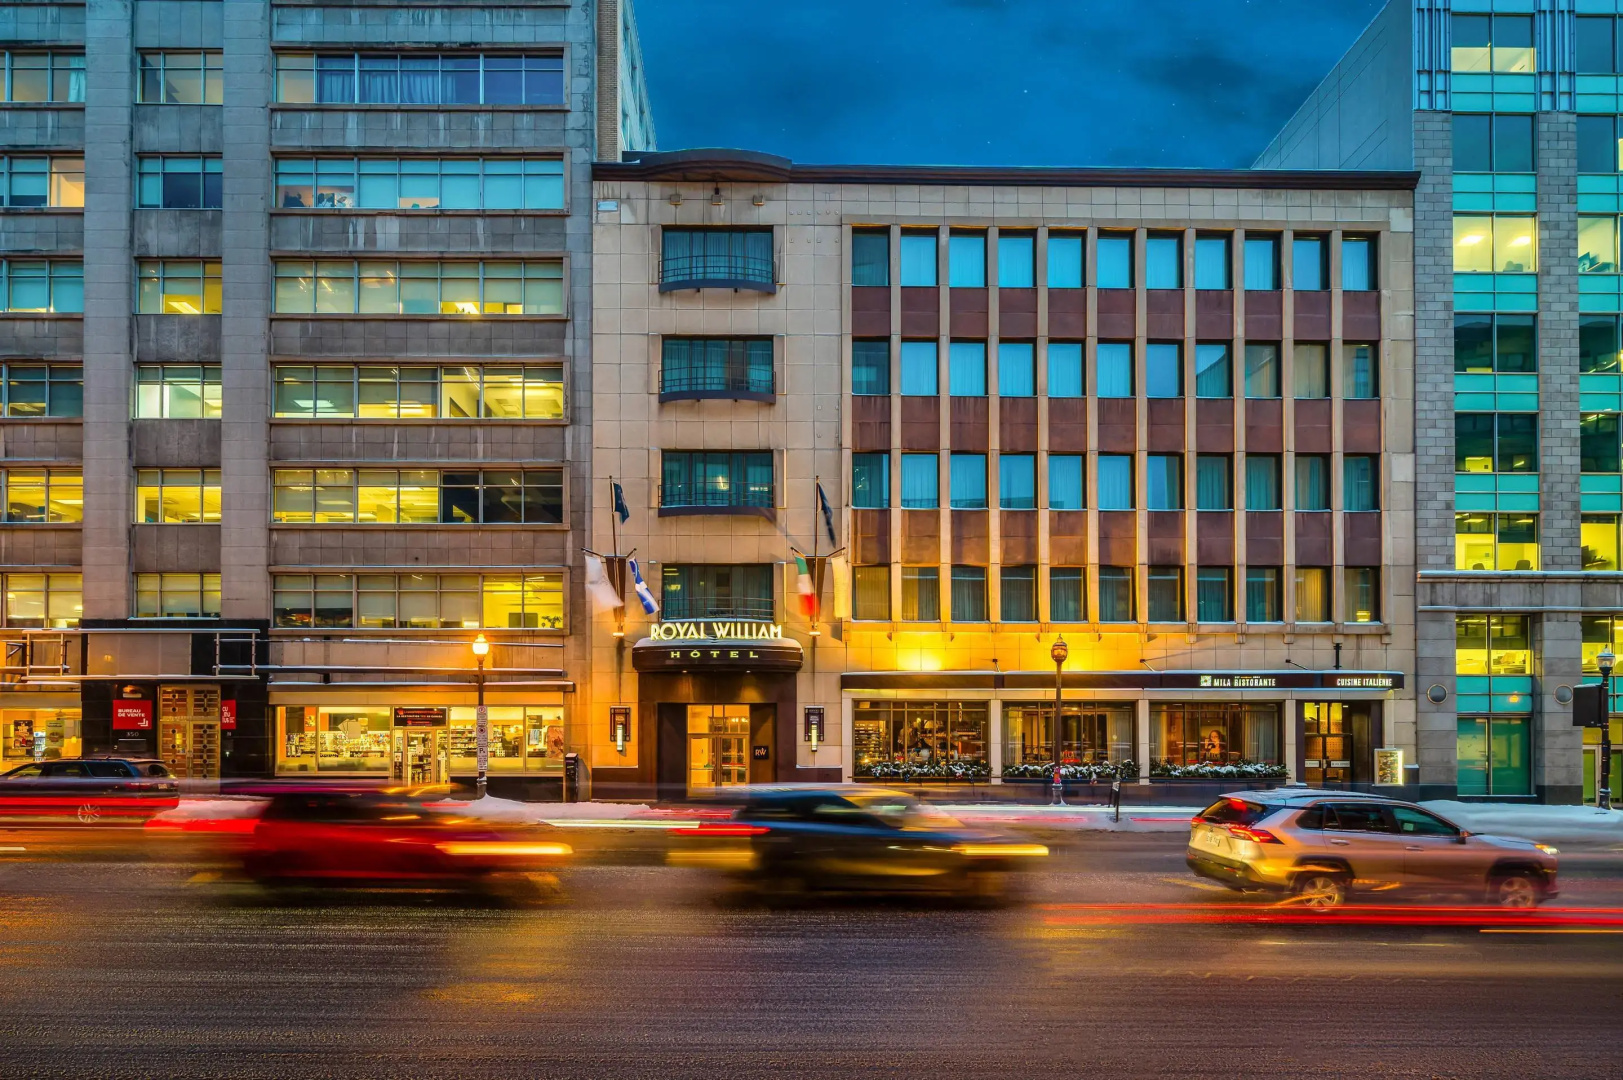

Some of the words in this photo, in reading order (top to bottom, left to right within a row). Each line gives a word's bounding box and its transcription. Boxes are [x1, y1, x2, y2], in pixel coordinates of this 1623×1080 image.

[650, 622, 705, 640] ROYAL
[712, 622, 783, 640] WILLIAM
[670, 650, 759, 658] HÔTEL
[1213, 678, 1231, 687] MILA
[1234, 678, 1276, 687] RISTORANTE
[1337, 678, 1361, 686] CUISINE
[1363, 678, 1392, 686] ITALIENNE
[755, 748, 767, 756] RW
